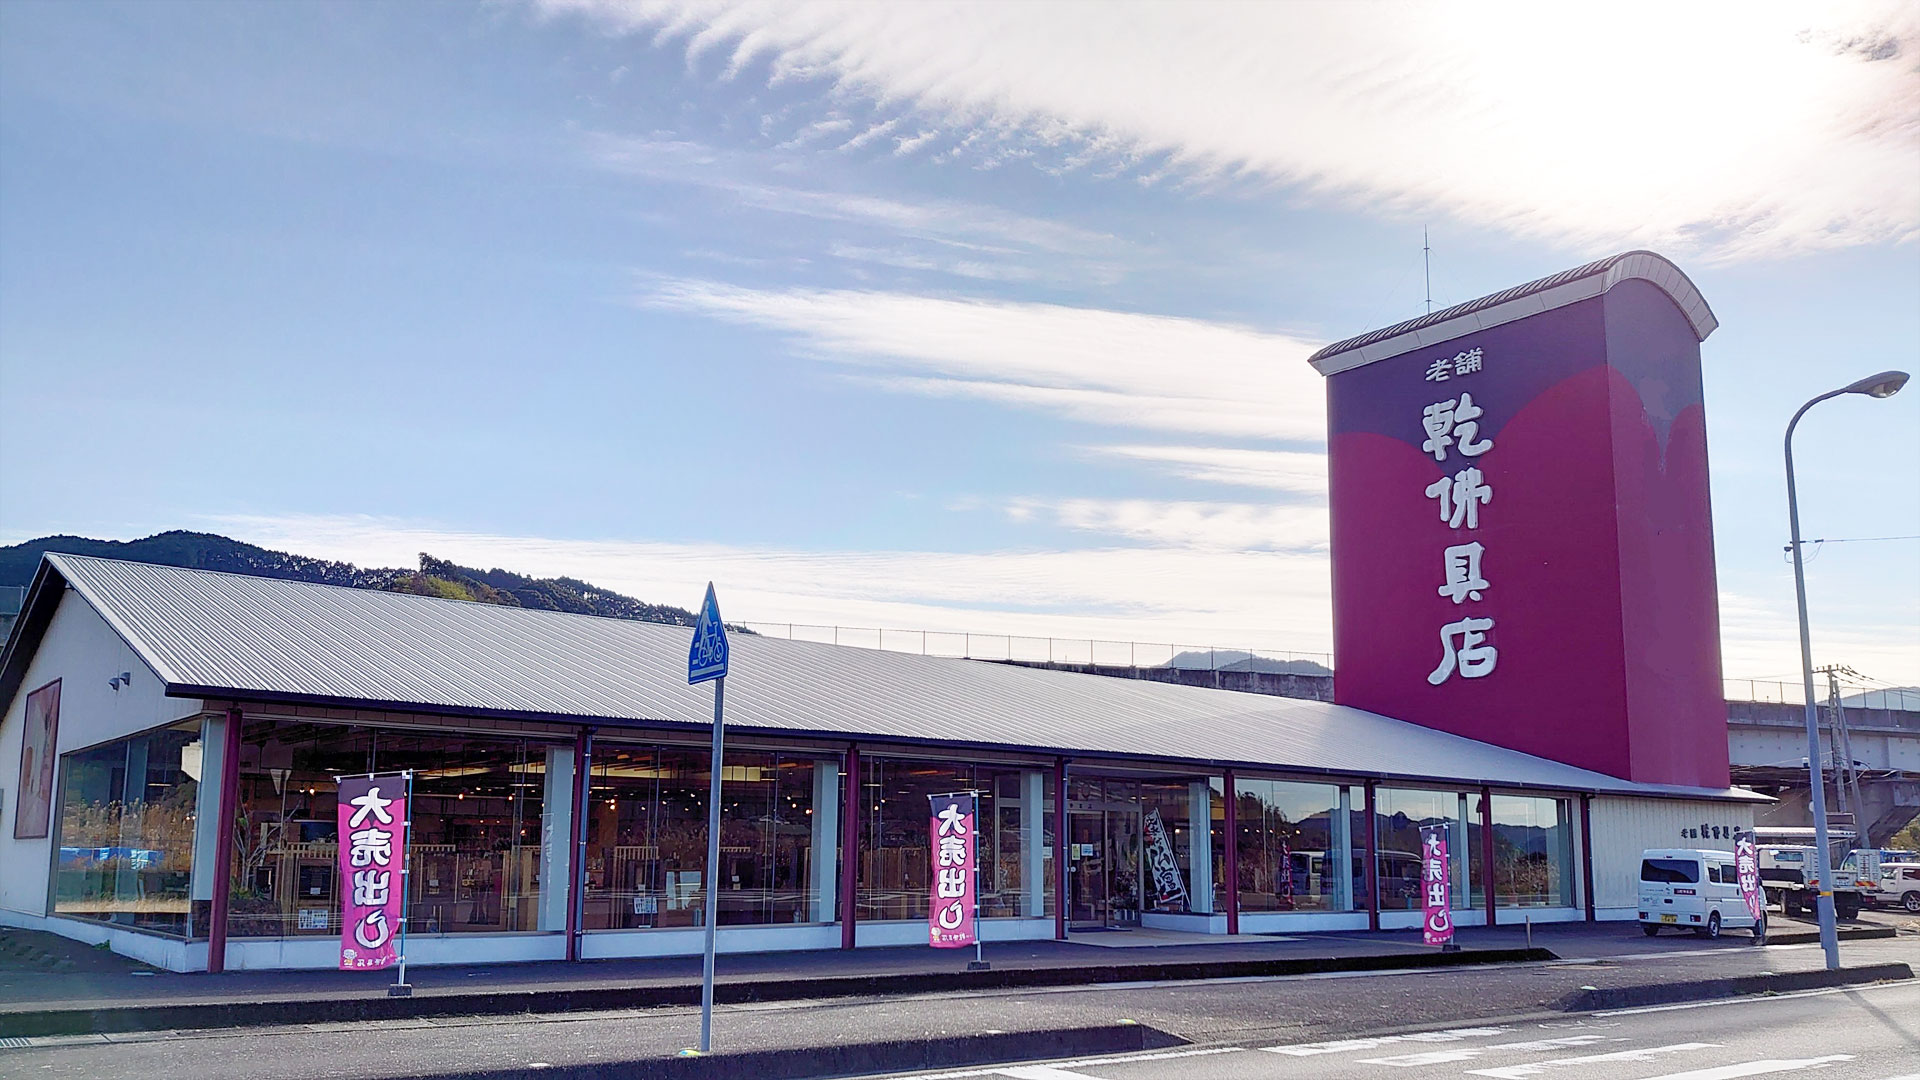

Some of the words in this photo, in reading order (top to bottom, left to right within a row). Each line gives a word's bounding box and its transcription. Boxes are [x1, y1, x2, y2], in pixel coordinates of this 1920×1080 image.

[1425, 347, 1484, 382] 老舗
[1422, 392, 1498, 686] 乾佛具店
